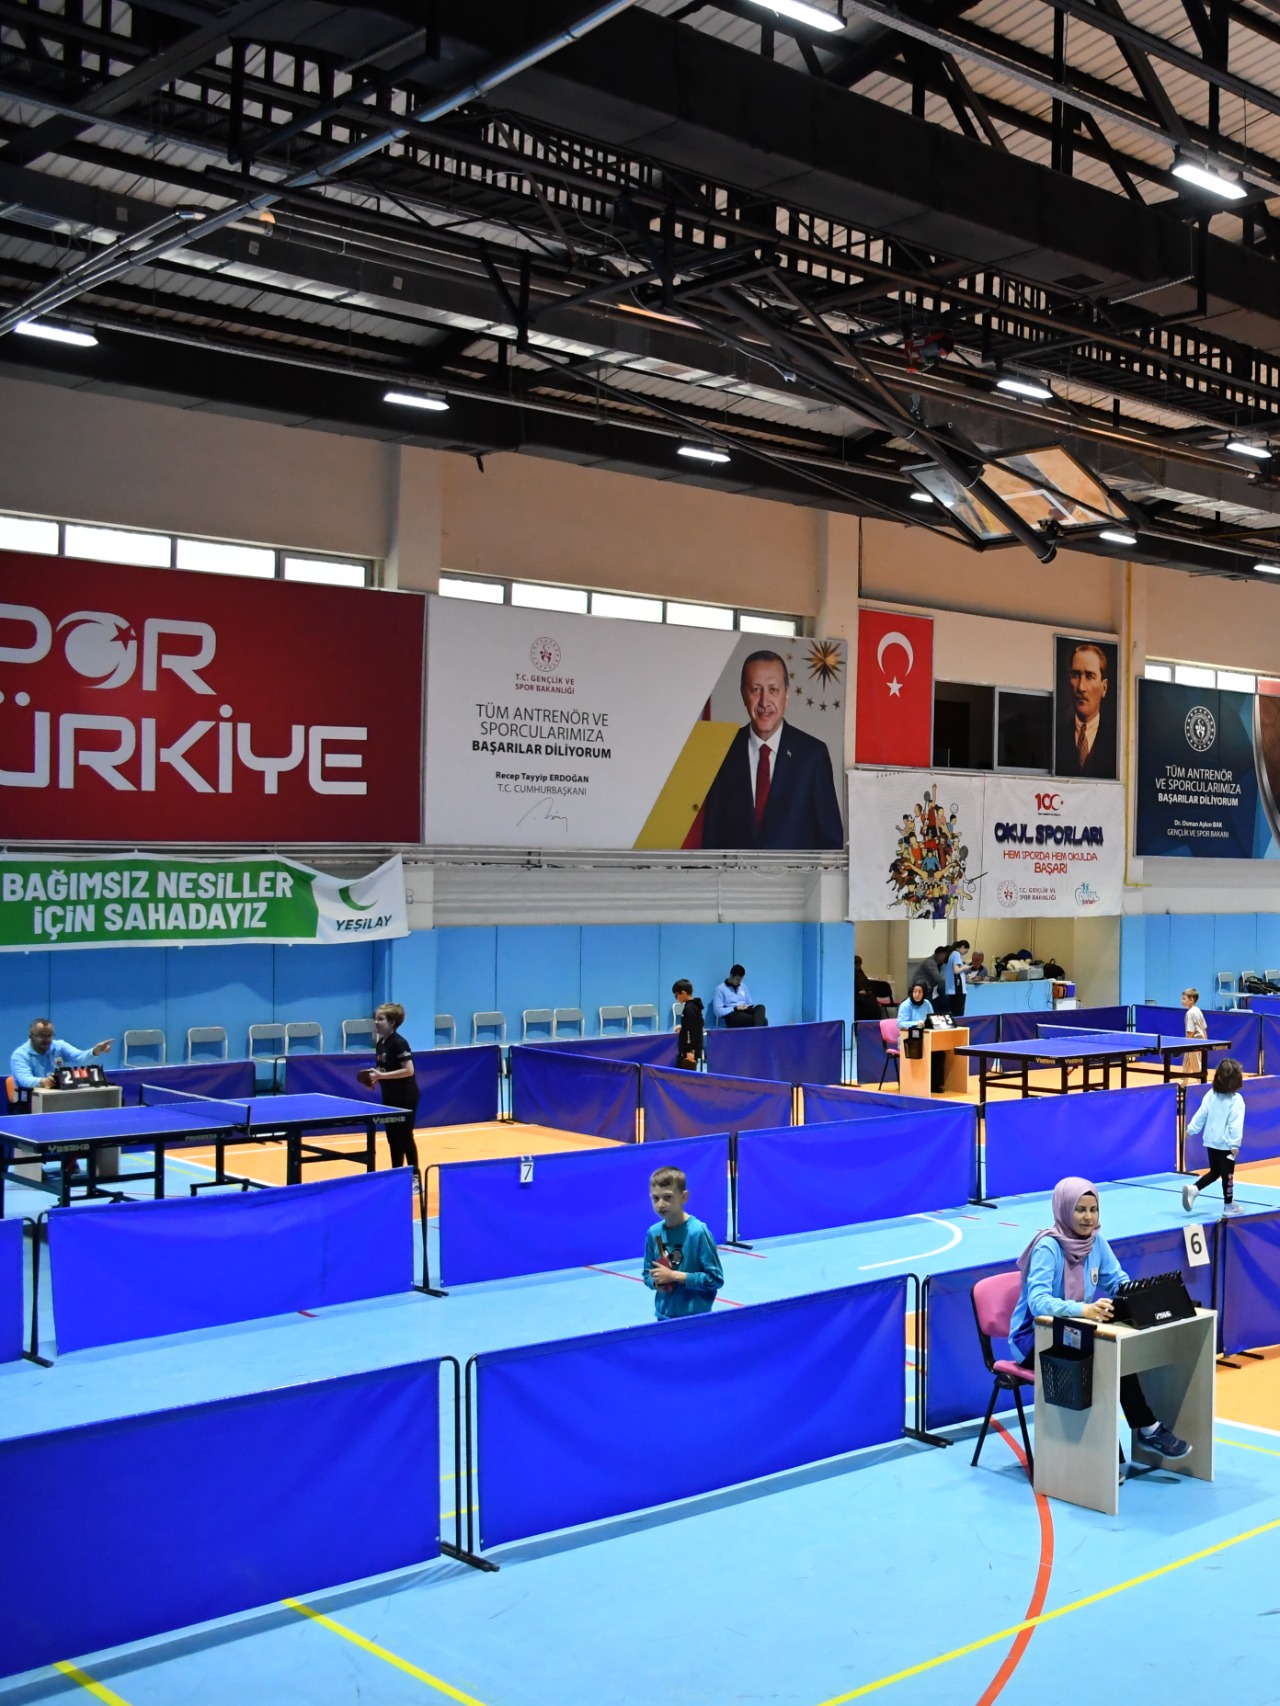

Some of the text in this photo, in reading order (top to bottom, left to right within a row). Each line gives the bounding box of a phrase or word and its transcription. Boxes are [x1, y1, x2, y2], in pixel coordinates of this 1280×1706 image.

[515, 673, 529, 681] T.C.
[531, 674, 563, 685] GENÇLİK
[515, 683, 575, 695] SPOR BAKANLIĞI
[476, 702, 609, 727] TÜM ANTRENÖR VE
[480, 721, 605, 743] SPORCULARIMIZA
[472, 740, 612, 759] BAŞARILAR DİLİYORUM
[495, 771, 589, 783] Recep Tayyip ERDOĞAN
[1165, 764, 1233, 782] TÜM ANTRENÖR
[514, 784, 587, 796] CUMHURBAŞKANI
[1155, 778, 1242, 794] VE SPORCULARIMIZA
[1158, 792, 1239, 807] BAŞARILAR DİLİYORUM
[994, 822, 1104, 847] OKUL SPORLARI
[1167, 828, 1189, 837] GENÇLİK
[1189, 829, 1196, 837] VE
[1210, 830, 1230, 838] BAKANI
[1003, 850, 1098, 861] HEM SPORDA HEM OKULDA
[1034, 862, 1067, 875] BAŞARI
[3, 869, 294, 902] BAĞIMSIZ NESİLLER
[34, 901, 267, 941] İÇİN SAHADAYIZ
[335, 914, 393, 933] YEŞİLAY
[62, 1070, 73, 1084] 2
[522, 1163, 533, 1181] 7
[1190, 1232, 1203, 1255] 6
